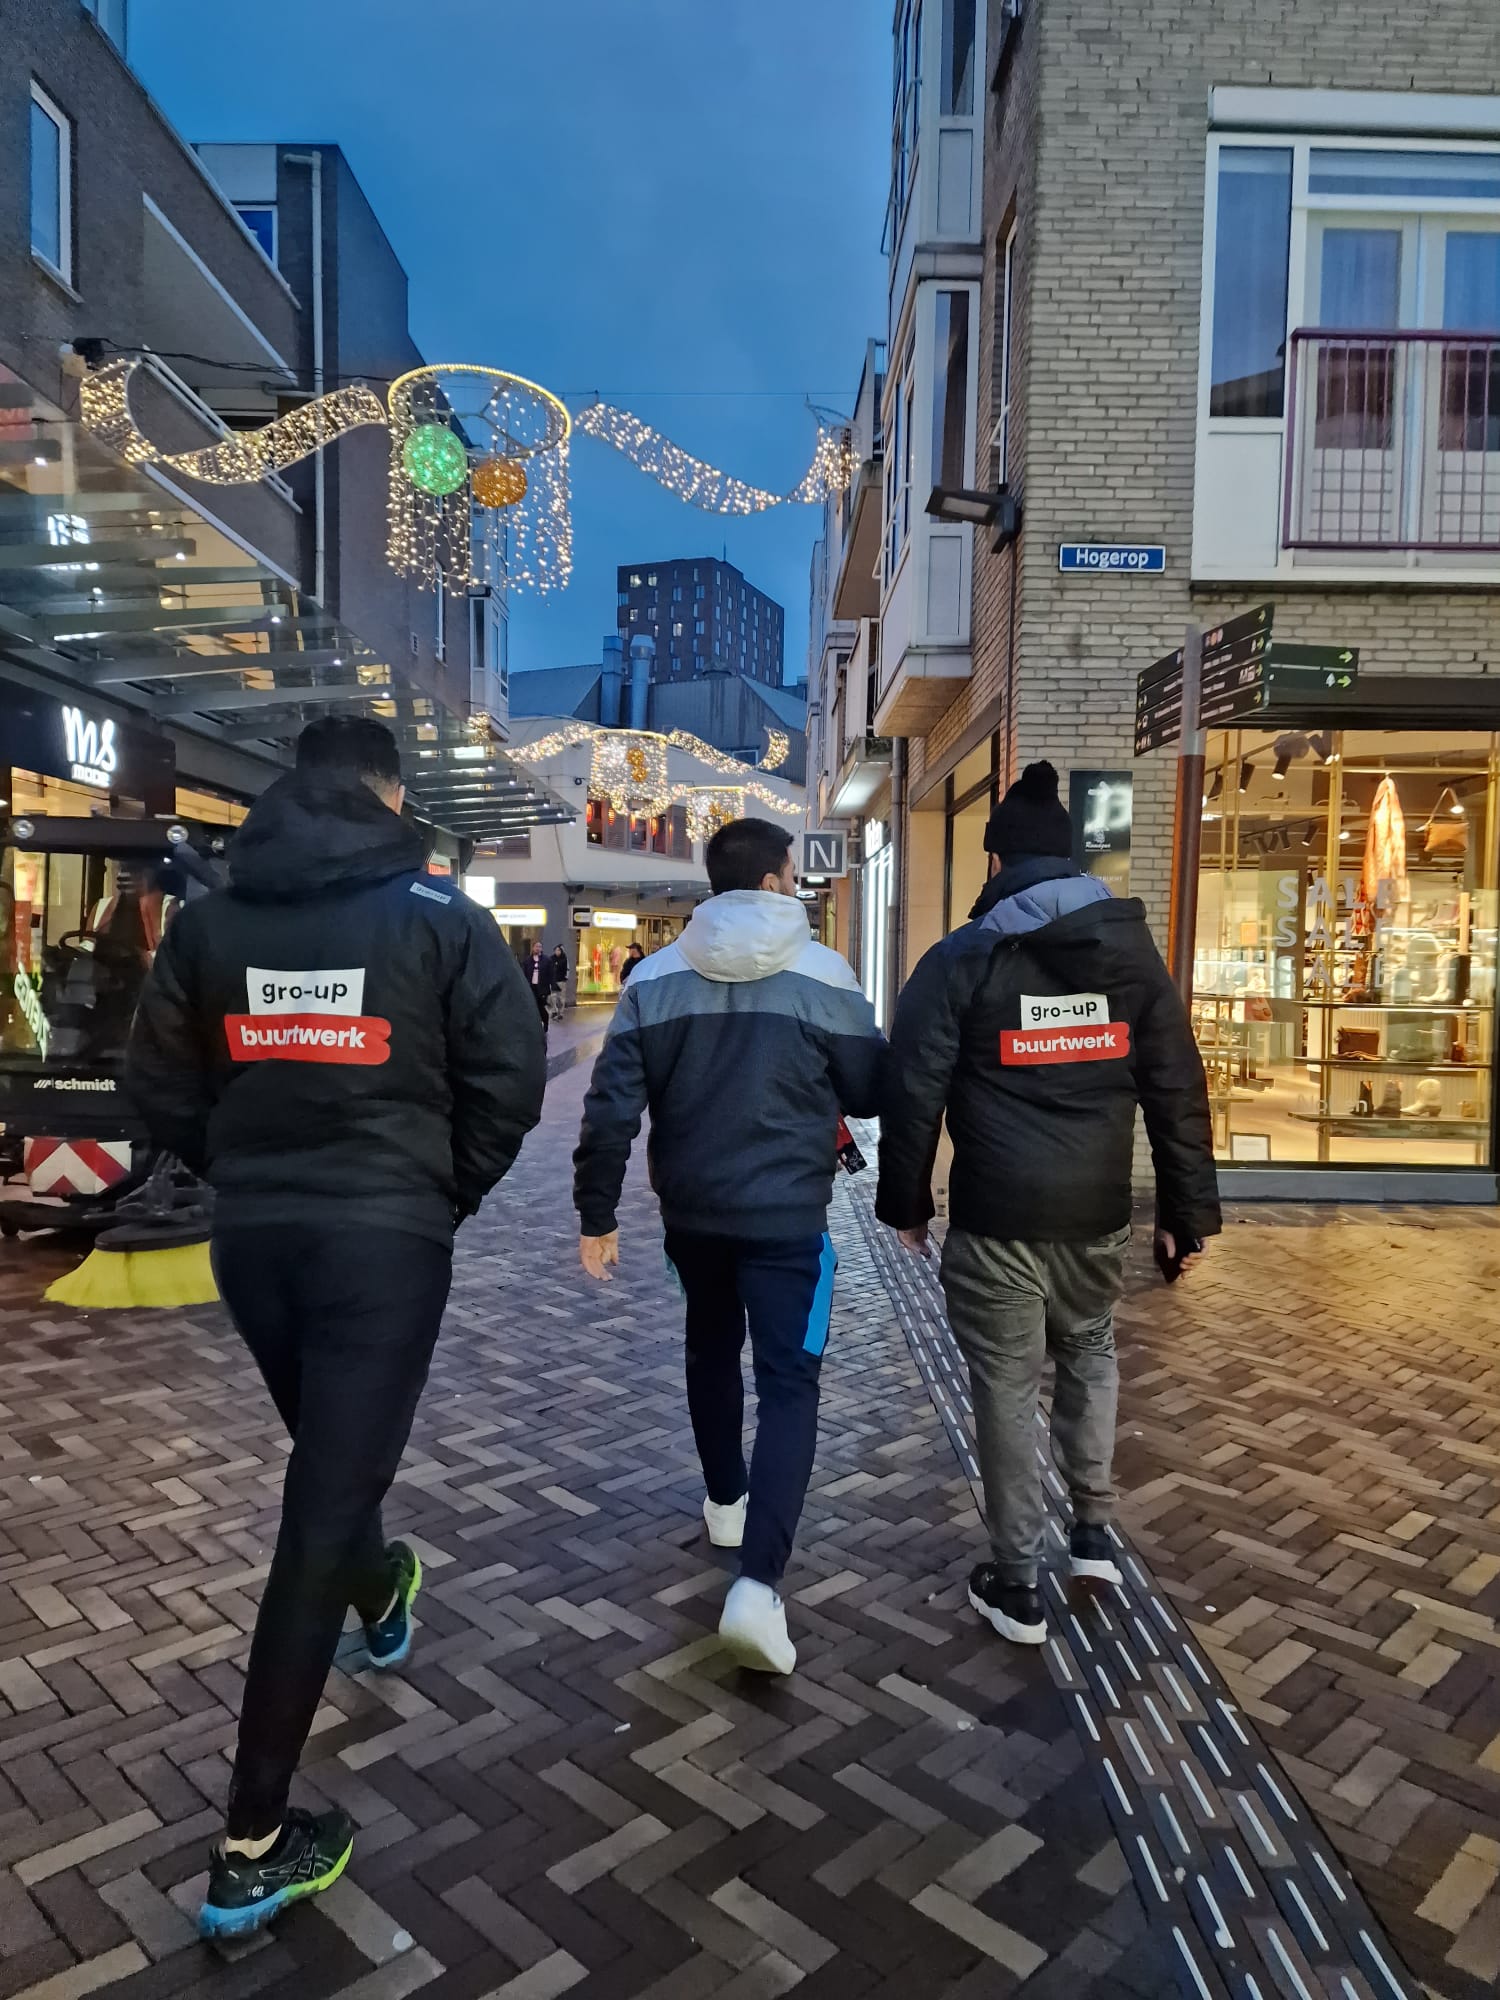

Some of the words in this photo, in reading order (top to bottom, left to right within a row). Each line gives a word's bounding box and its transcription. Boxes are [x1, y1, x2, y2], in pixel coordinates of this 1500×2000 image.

[1076, 548, 1149, 569] Hogerop
[809, 840, 837, 869] N
[1276, 876, 1398, 910] SALE
[1276, 915, 1394, 949] SALE
[262, 982, 348, 1004] gro-up
[1031, 1001, 1098, 1021] gro-up
[240, 1025, 367, 1049] buurtwerk
[1012, 1032, 1117, 1054] buurtwerk
[54, 1077, 117, 1092] schmidt
